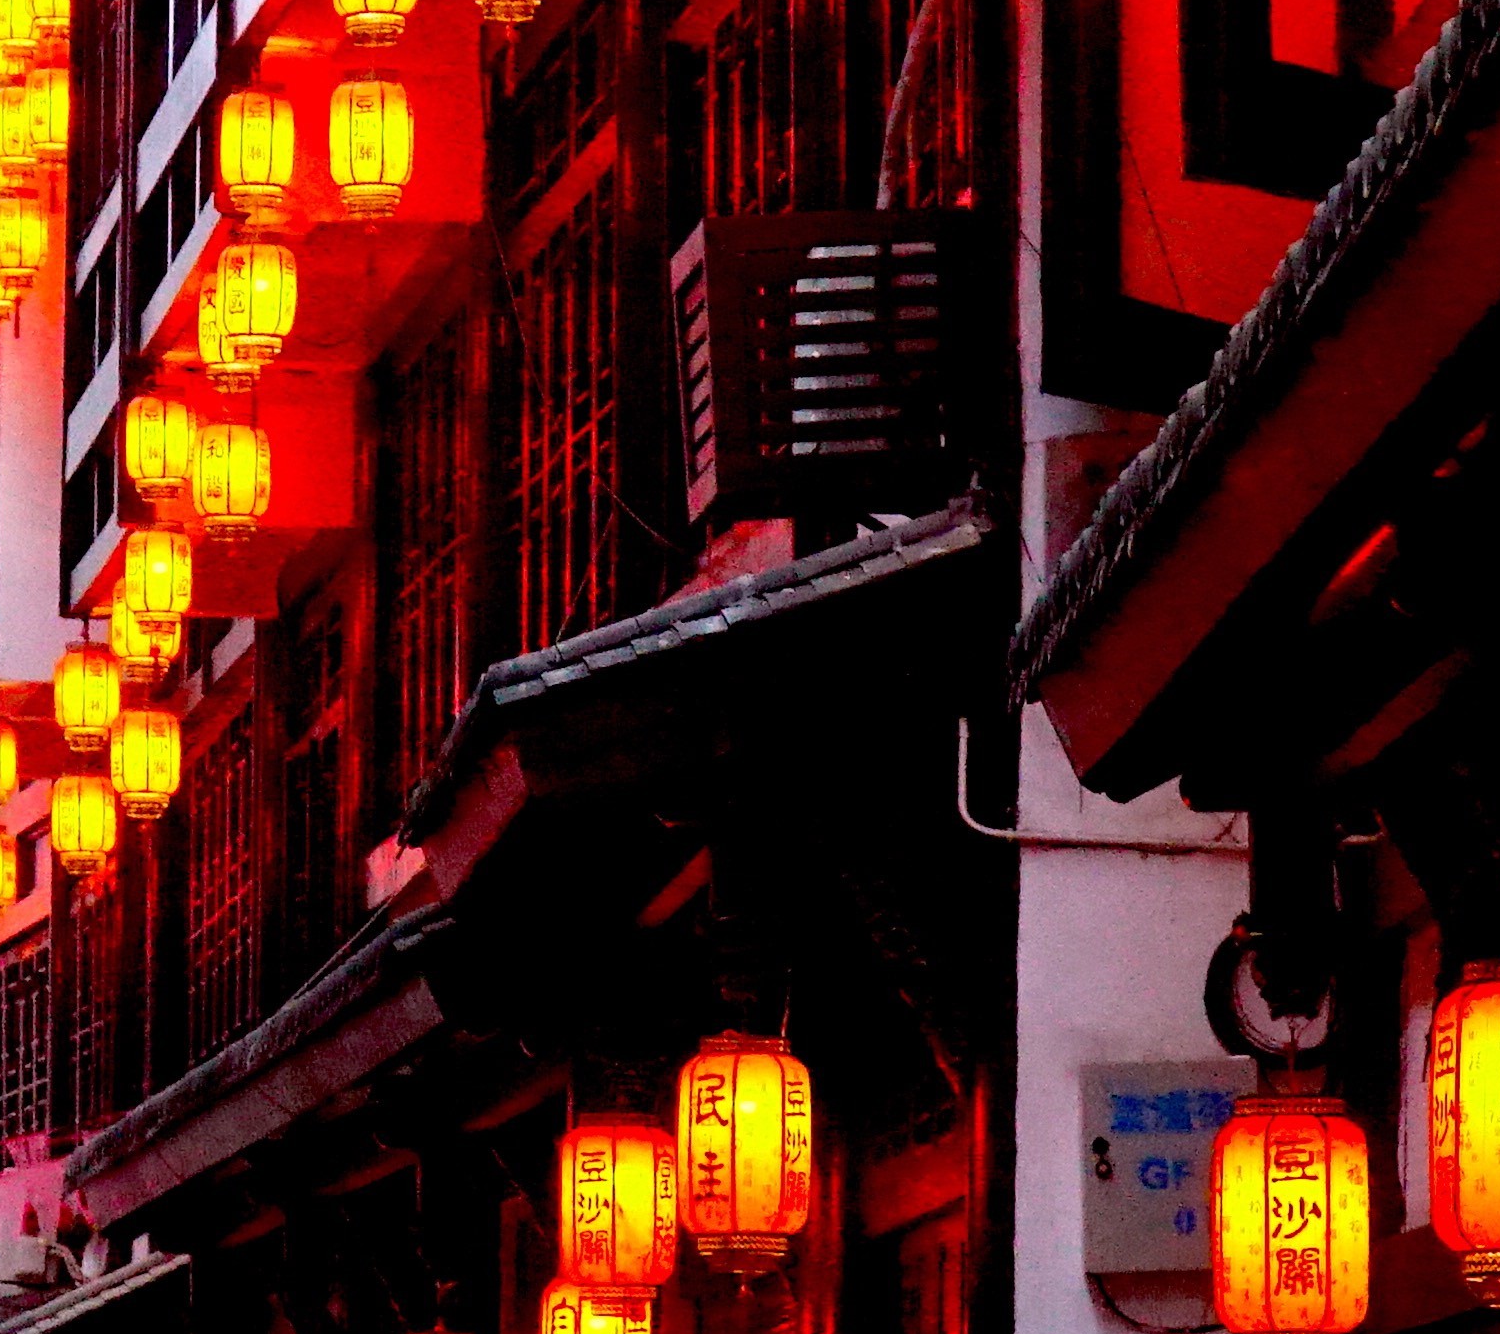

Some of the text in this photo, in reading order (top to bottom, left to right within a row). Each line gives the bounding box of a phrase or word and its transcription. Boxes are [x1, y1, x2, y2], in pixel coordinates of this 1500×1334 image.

[697, 1074, 727, 1205] 民主
[785, 1082, 808, 1210] 豆沙關
[578, 1151, 609, 1264] 豆沙關
[1272, 1138, 1323, 1296] 豆沙關
